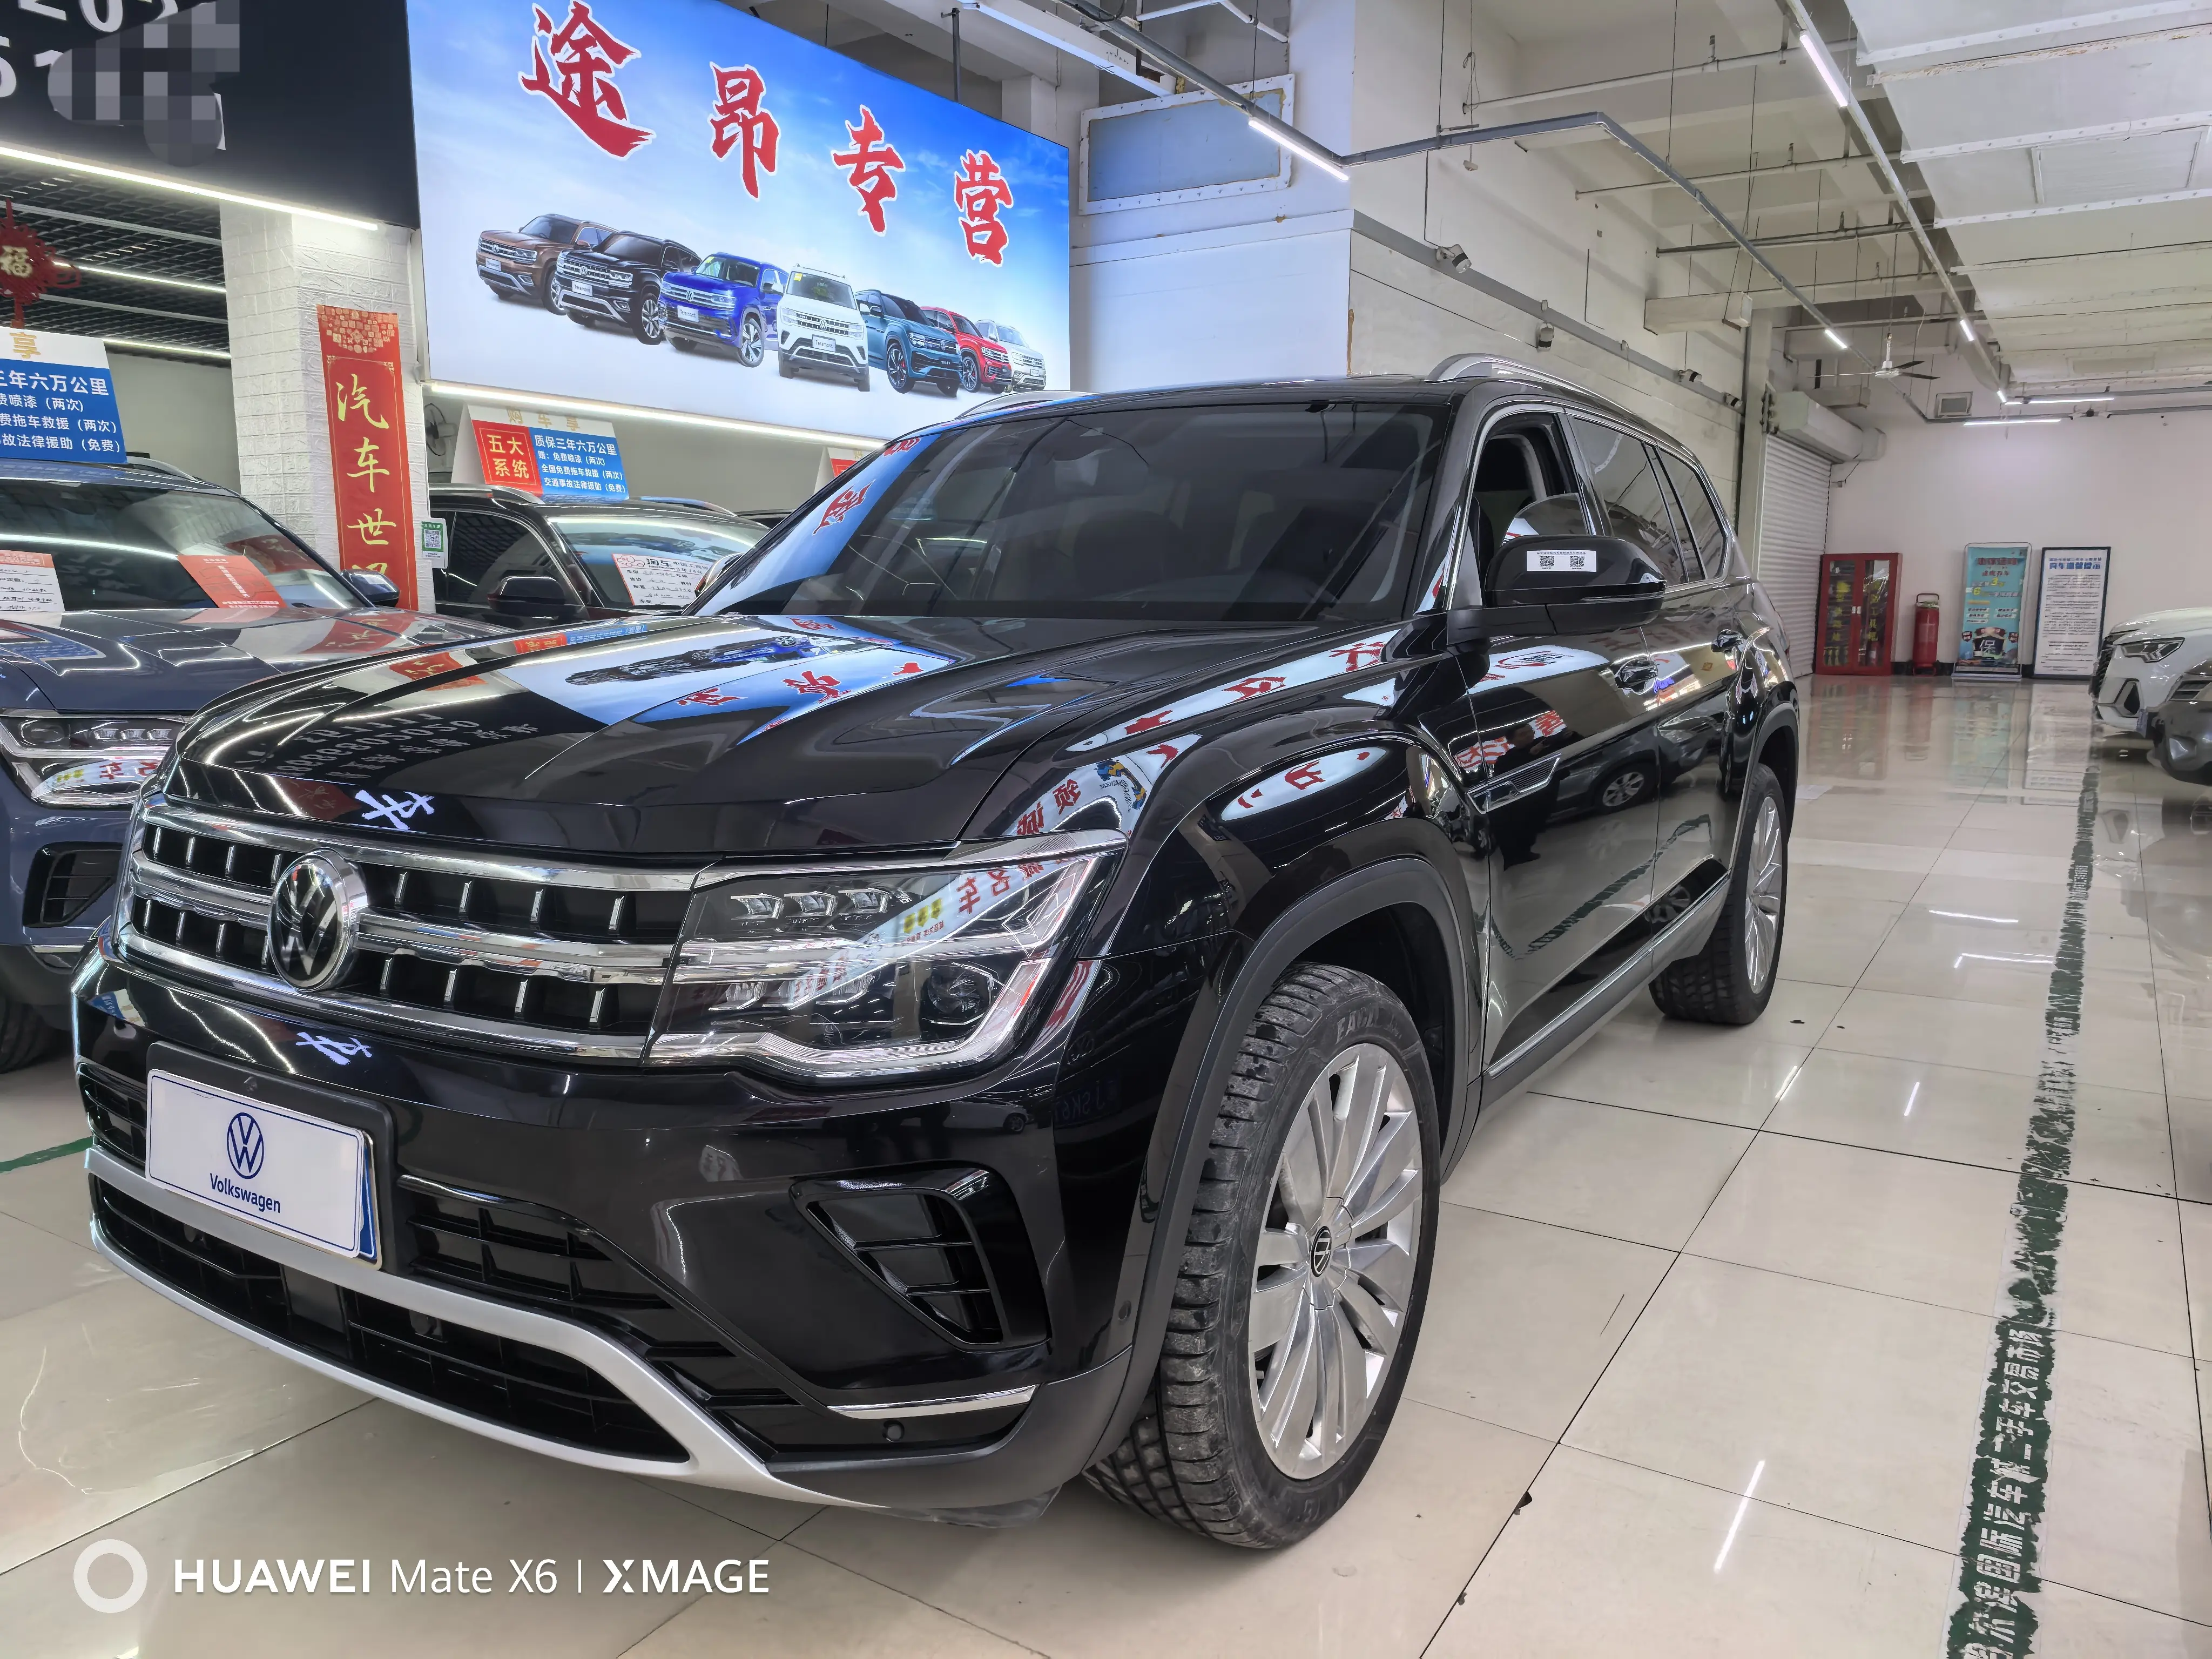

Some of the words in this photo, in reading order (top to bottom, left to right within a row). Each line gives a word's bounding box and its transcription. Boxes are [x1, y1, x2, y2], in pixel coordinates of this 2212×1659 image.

[518, 0, 1014, 267] 途昂专营
[574, 284, 591, 292] Teramont
[680, 308, 697, 319] Teramont
[9, 332, 41, 359] 享
[815, 340, 834, 349] Teramont
[0, 433, 120, 452] 故法律援助（免费）
[487, 434, 524, 455] 五大
[534, 434, 617, 456] 质保三年六万公里
[493, 458, 530, 479] 系统
[210, 1172, 281, 1213] Volkswagen
